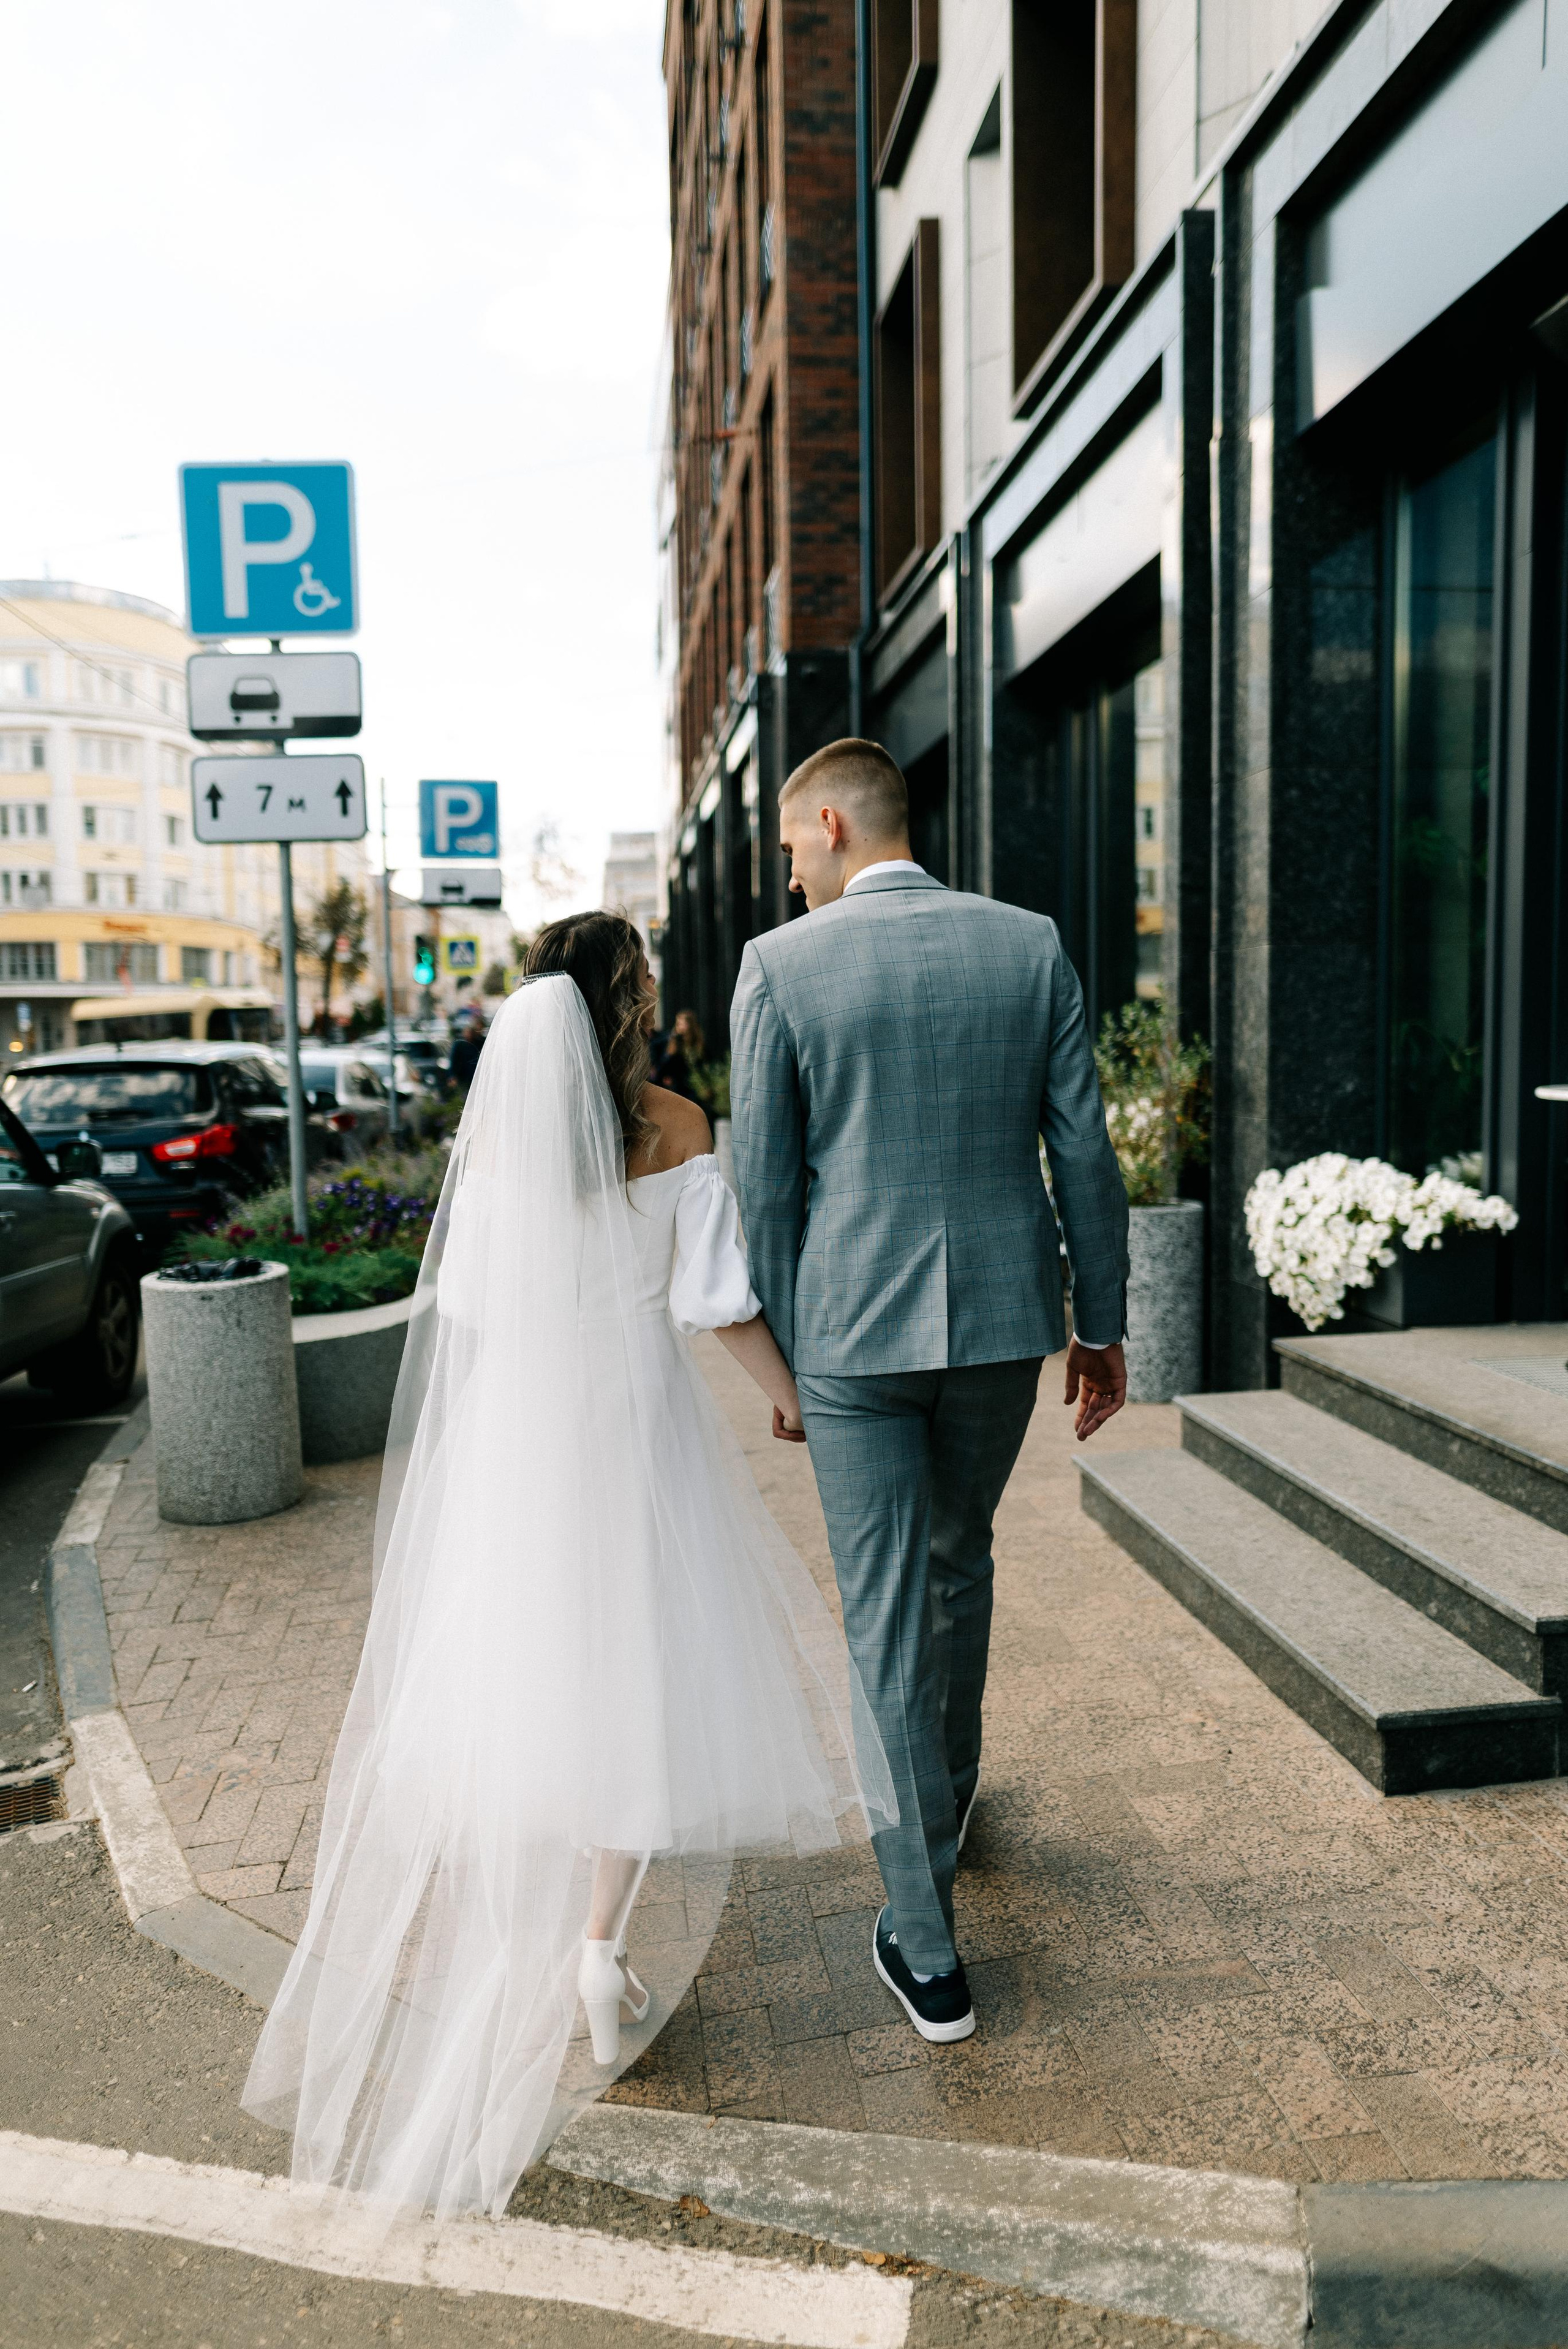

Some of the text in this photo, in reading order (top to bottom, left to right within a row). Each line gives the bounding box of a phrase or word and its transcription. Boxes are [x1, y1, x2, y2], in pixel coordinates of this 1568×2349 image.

[217, 480, 317, 619] P
[256, 784, 273, 813] 7
[434, 785, 483, 853] P
